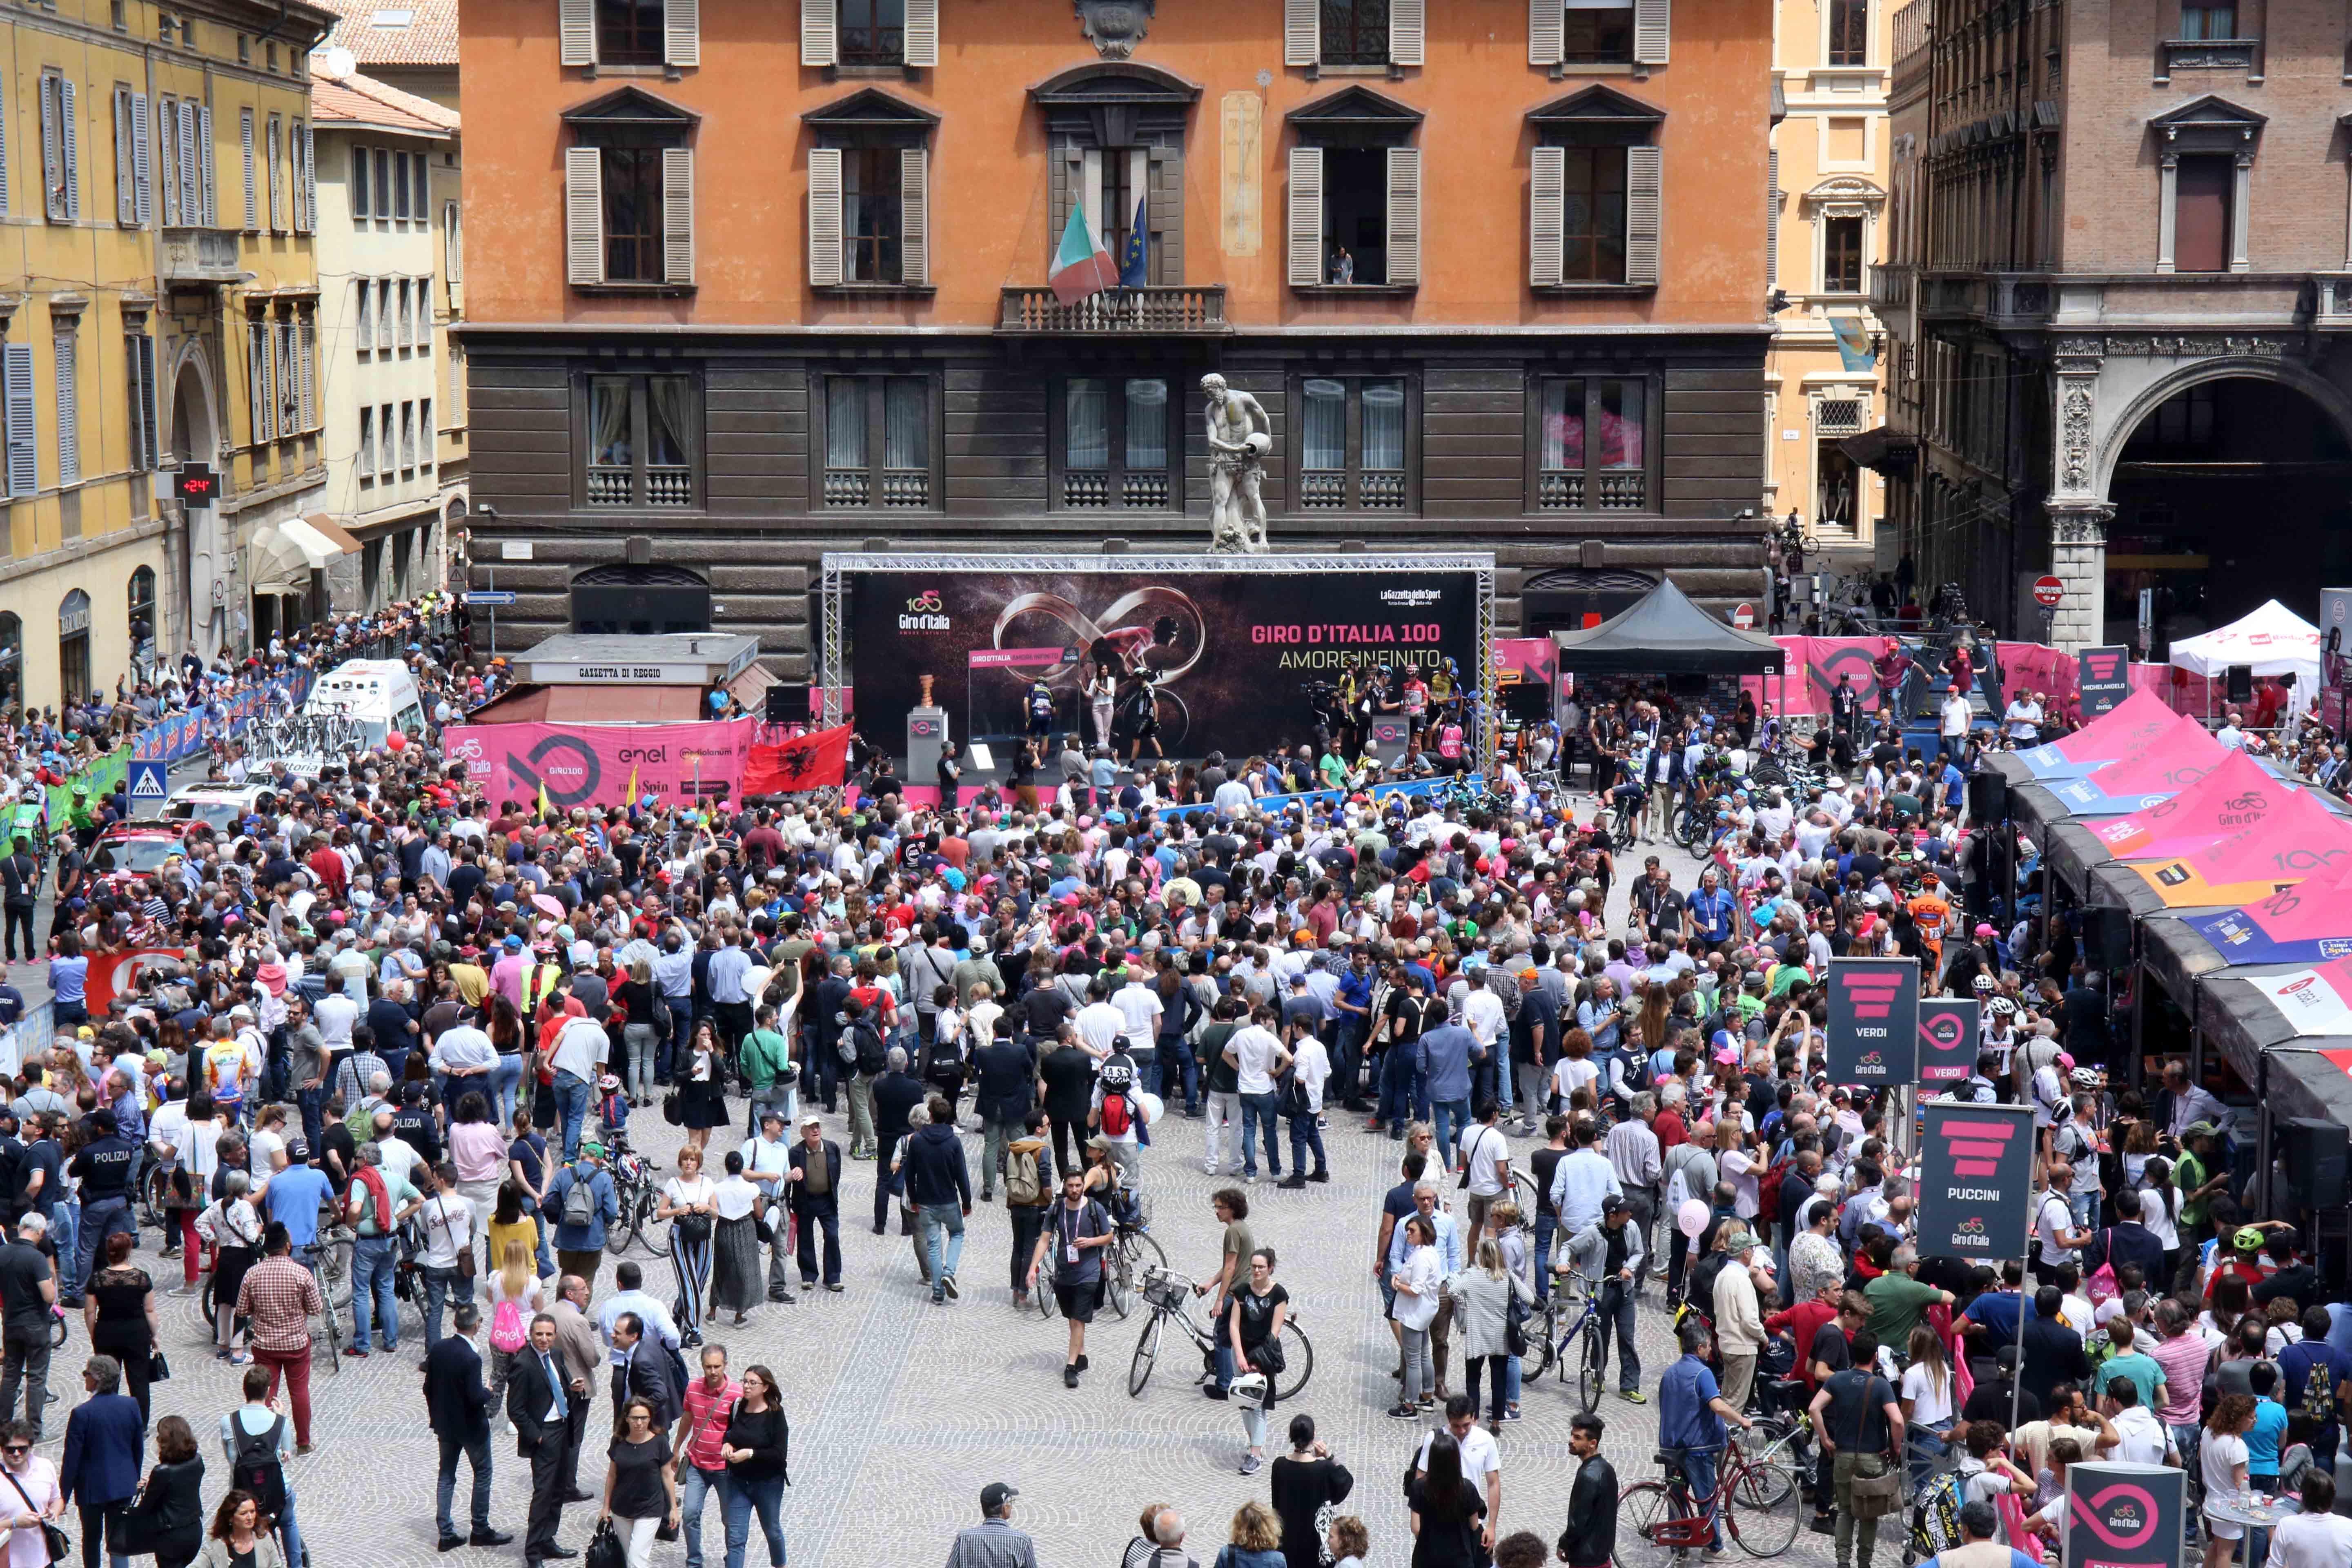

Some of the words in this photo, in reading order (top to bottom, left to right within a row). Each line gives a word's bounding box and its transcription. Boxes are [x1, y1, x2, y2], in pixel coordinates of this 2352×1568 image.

[899, 614, 918, 629] Giro
[919, 614, 950, 629] d'Italia
[1252, 626, 1301, 644] GIRO
[1308, 624, 1394, 643] D'ITALIA
[1401, 624, 1440, 642] 100
[1359, 649, 1440, 669] INFINITO
[579, 668, 619, 679] GAZZETTA
[621, 668, 630, 678] DI
[633, 668, 661, 678] REGGIO
[2082, 682, 2125, 691] MICHELANGELO
[619, 745, 666, 763] enel
[642, 780, 668, 794] Spin
[1856, 1028, 1886, 1037] VERDI
[1855, 1065, 1867, 1074] Giro
[1868, 1065, 1886, 1074] d'Italia
[1934, 1068, 1960, 1078] VERDI
[392, 1118, 421, 1128] OLIZIA
[94, 1151, 130, 1164] POLIZIA
[1948, 1188, 2000, 1201] PUCCINI
[1952, 1233, 1967, 1246] Giro
[1967, 1233, 1989, 1246] d'Italia
[494, 1327, 521, 1341] enel
[2109, 1517, 2121, 1528] Giro
[2122, 1517, 2140, 1528] d'Italia
